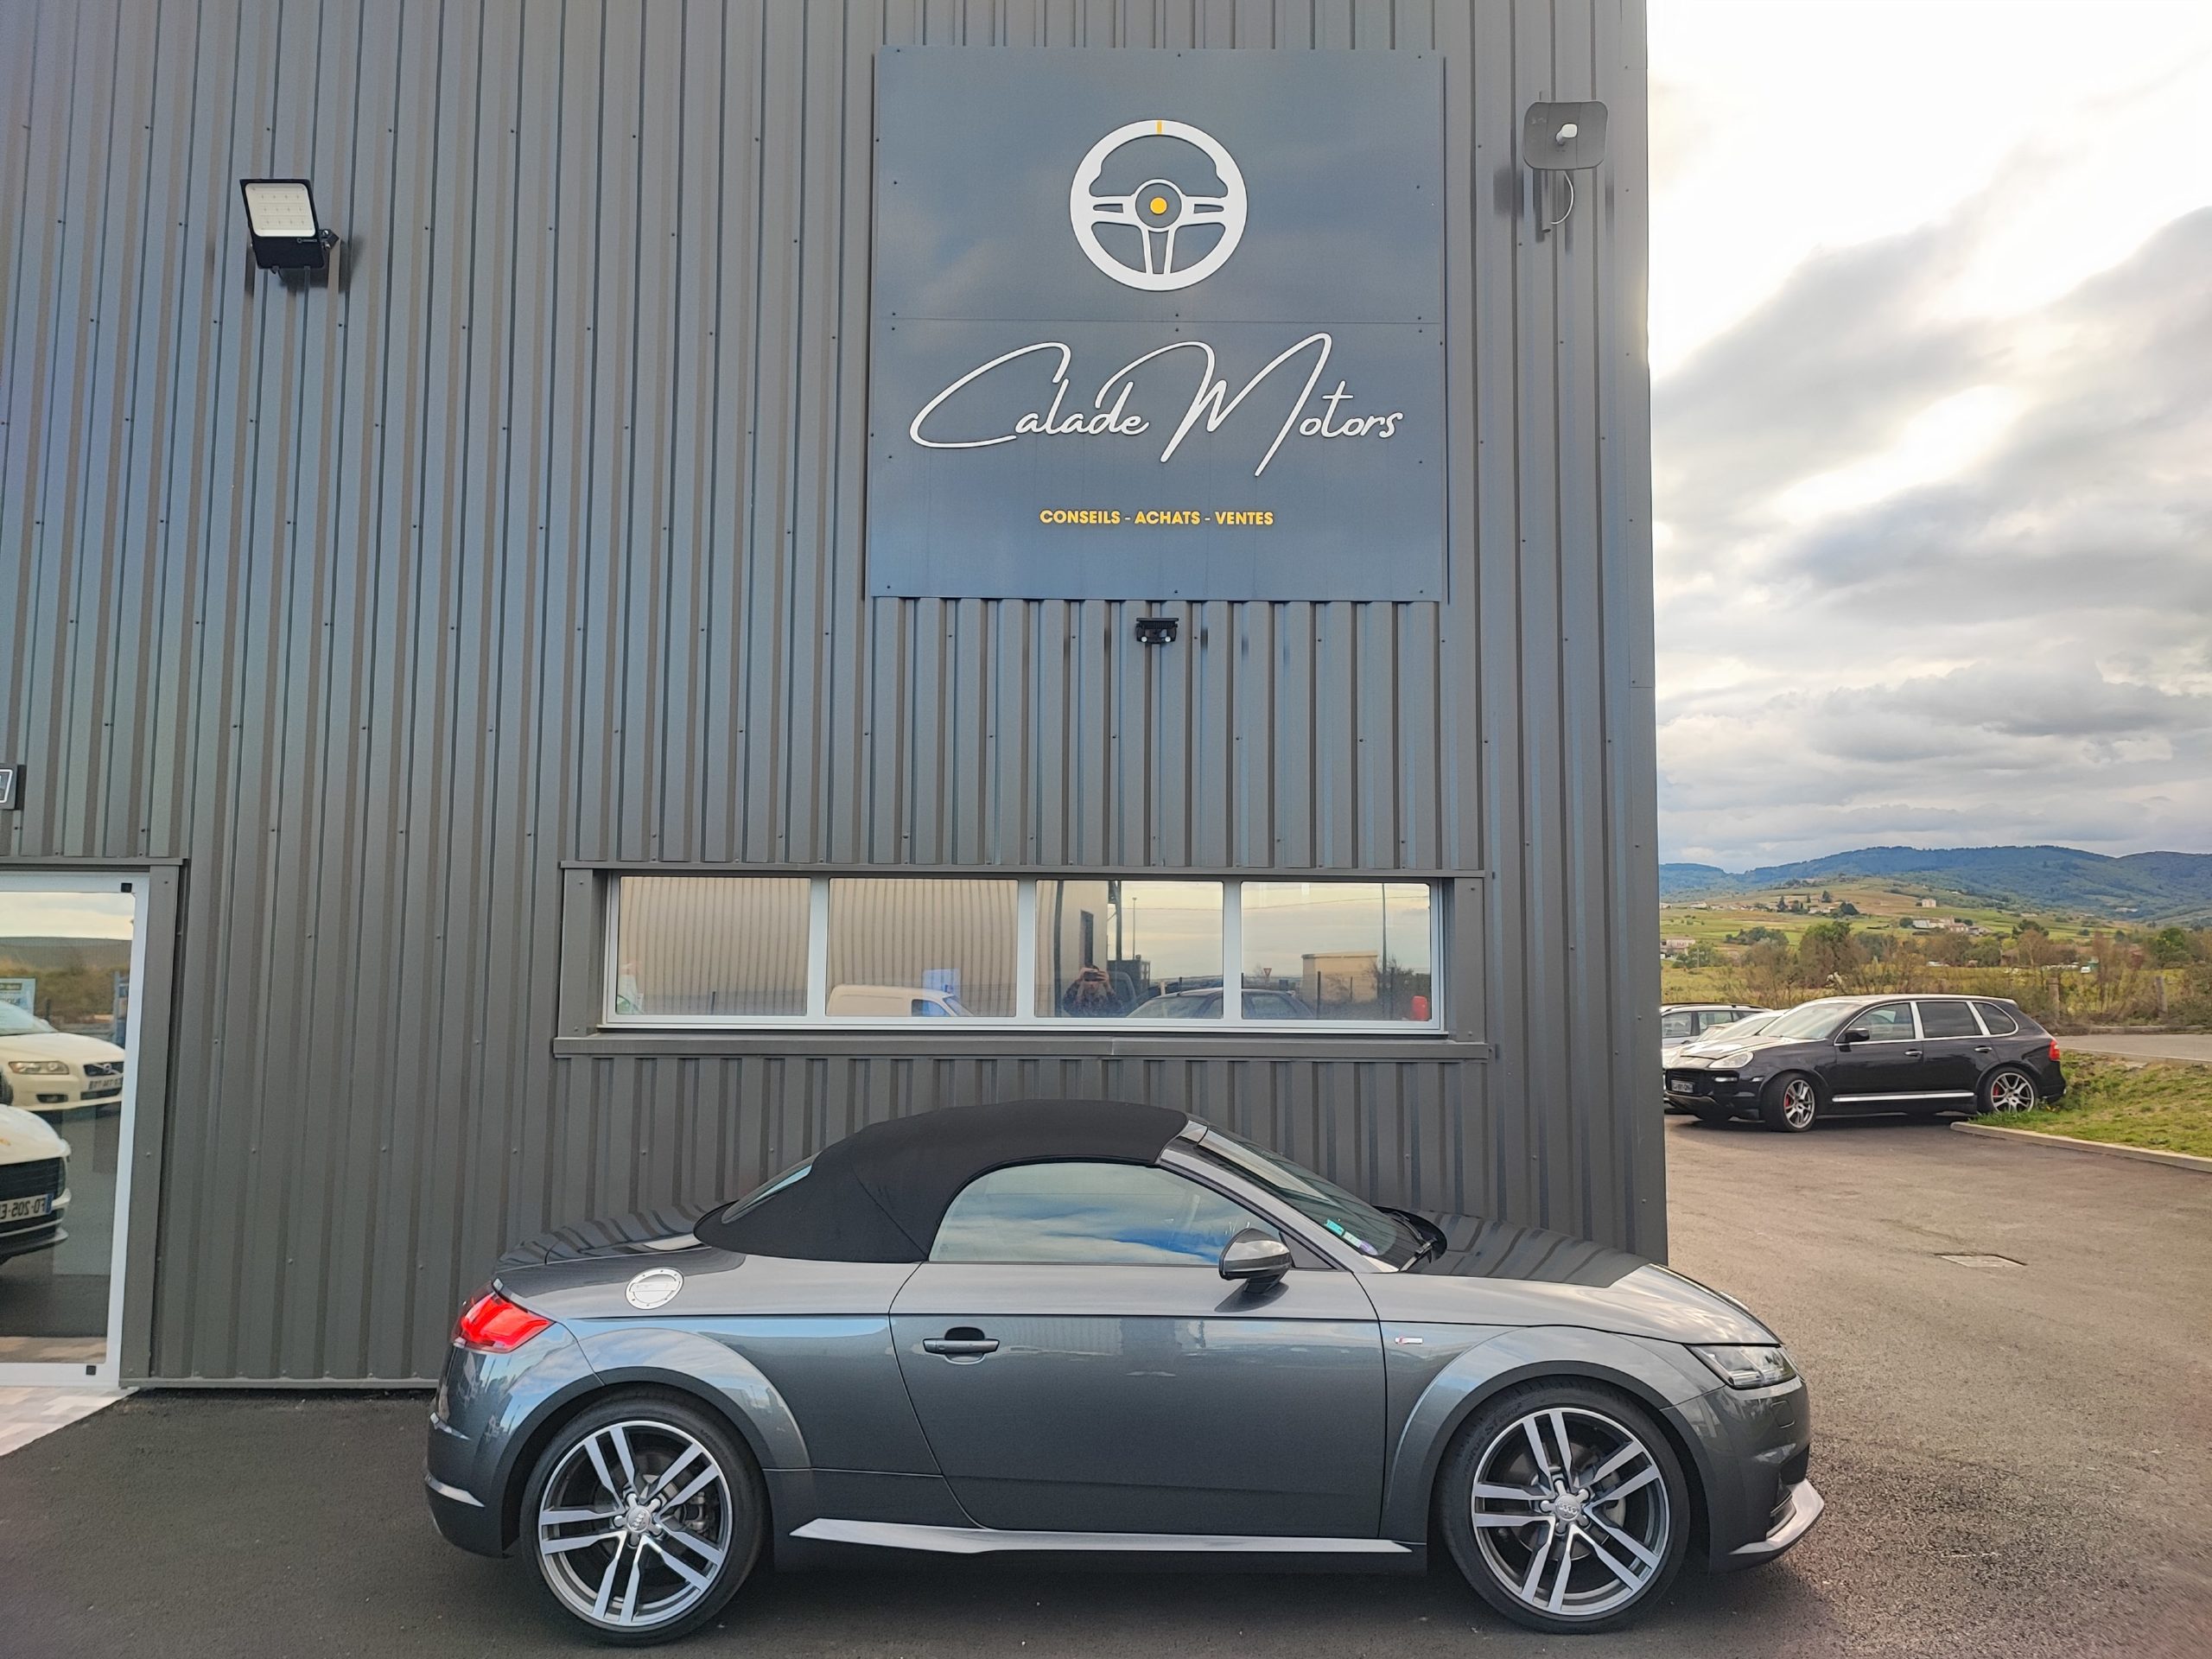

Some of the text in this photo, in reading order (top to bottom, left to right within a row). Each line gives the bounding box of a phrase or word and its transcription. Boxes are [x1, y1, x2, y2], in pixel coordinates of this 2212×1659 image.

[909, 333, 1404, 476] Calade Motors
[1039, 510, 1121, 525] CONSEILS
[1135, 511, 1201, 525] ACHATS
[1215, 511, 1274, 526] VENTES
